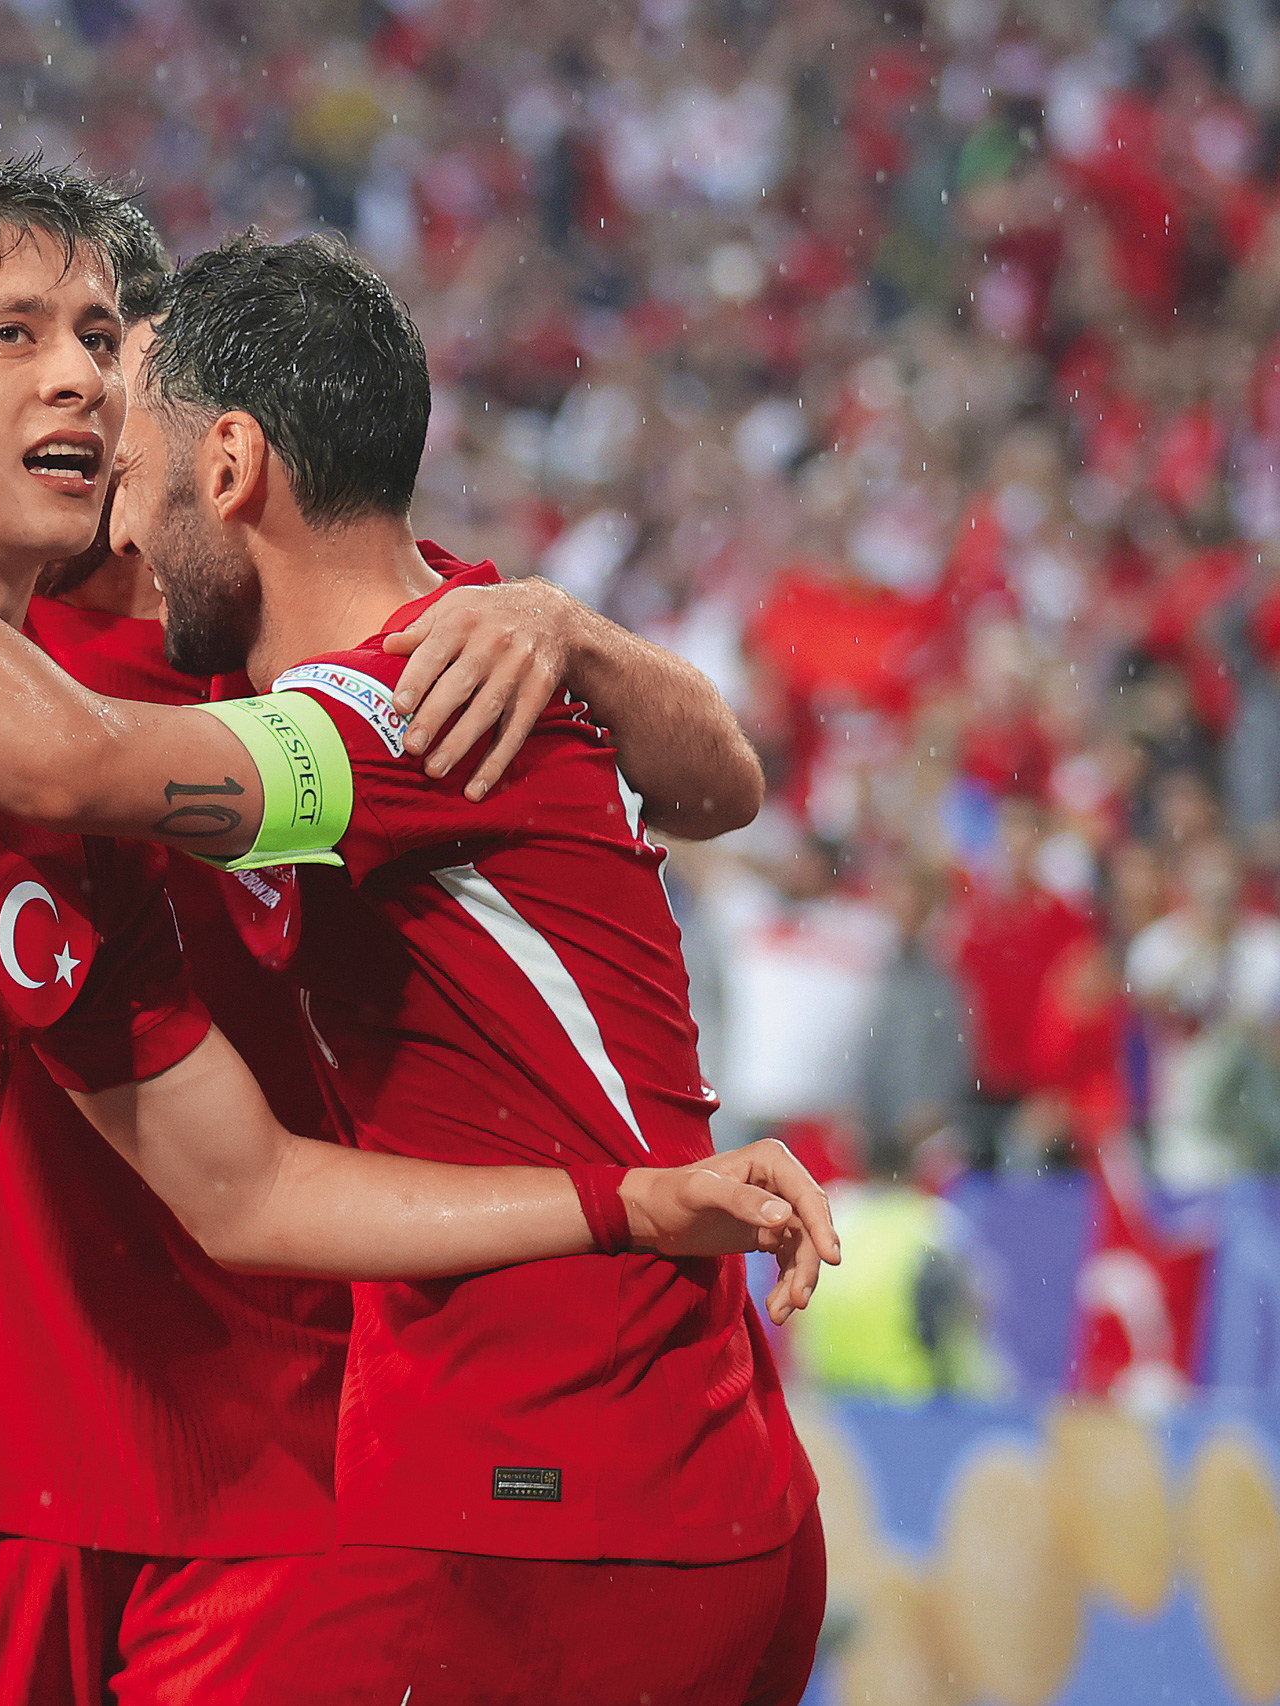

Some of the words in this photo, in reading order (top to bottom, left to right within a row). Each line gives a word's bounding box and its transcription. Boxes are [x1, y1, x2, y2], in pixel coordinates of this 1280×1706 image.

[369, 713, 383, 726] for
[261, 713, 318, 826] RESPECT
[152, 776, 245, 838] 10
